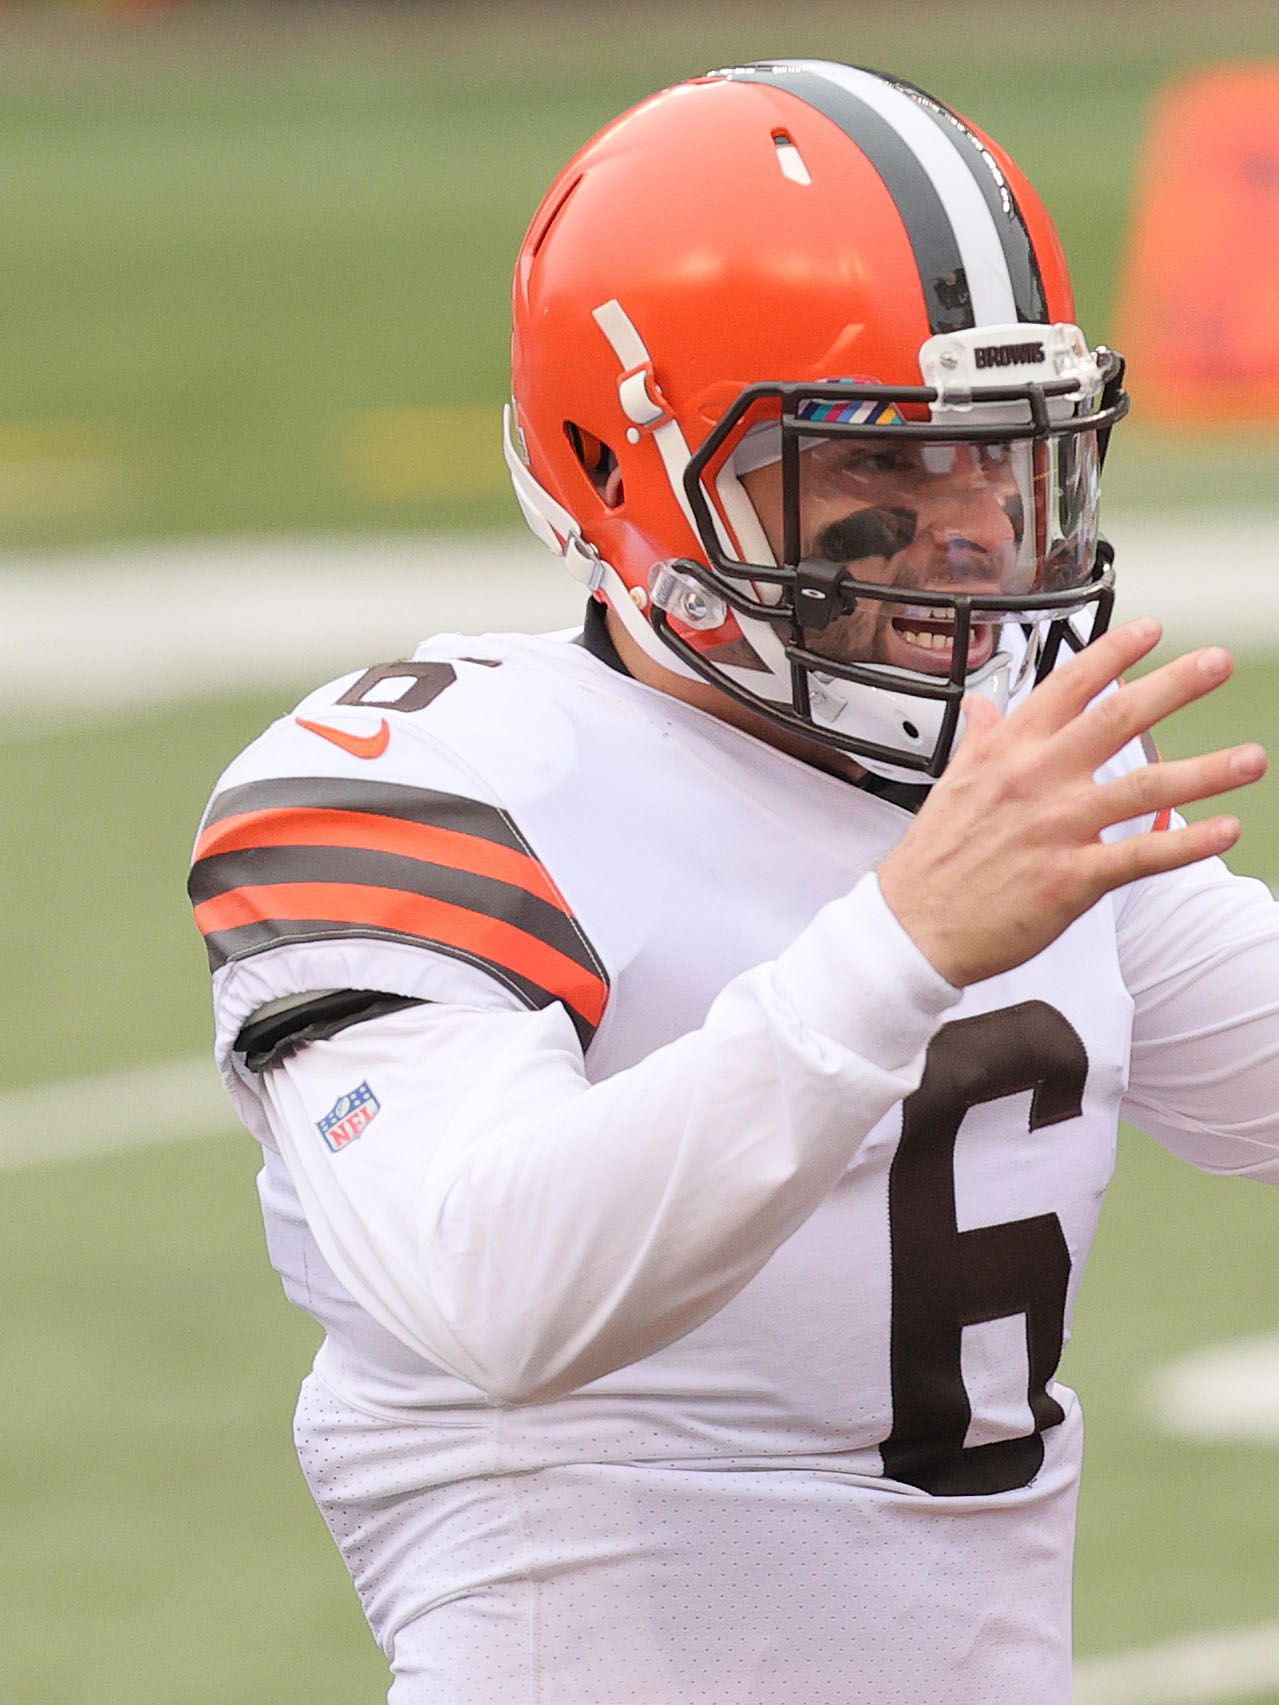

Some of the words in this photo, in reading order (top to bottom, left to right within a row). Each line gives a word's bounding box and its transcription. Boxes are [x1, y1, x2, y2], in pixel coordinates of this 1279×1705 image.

[974, 342, 1046, 369] BROWNS
[328, 1105, 374, 1148] NFL
[878, 1000, 1089, 1497] 6
